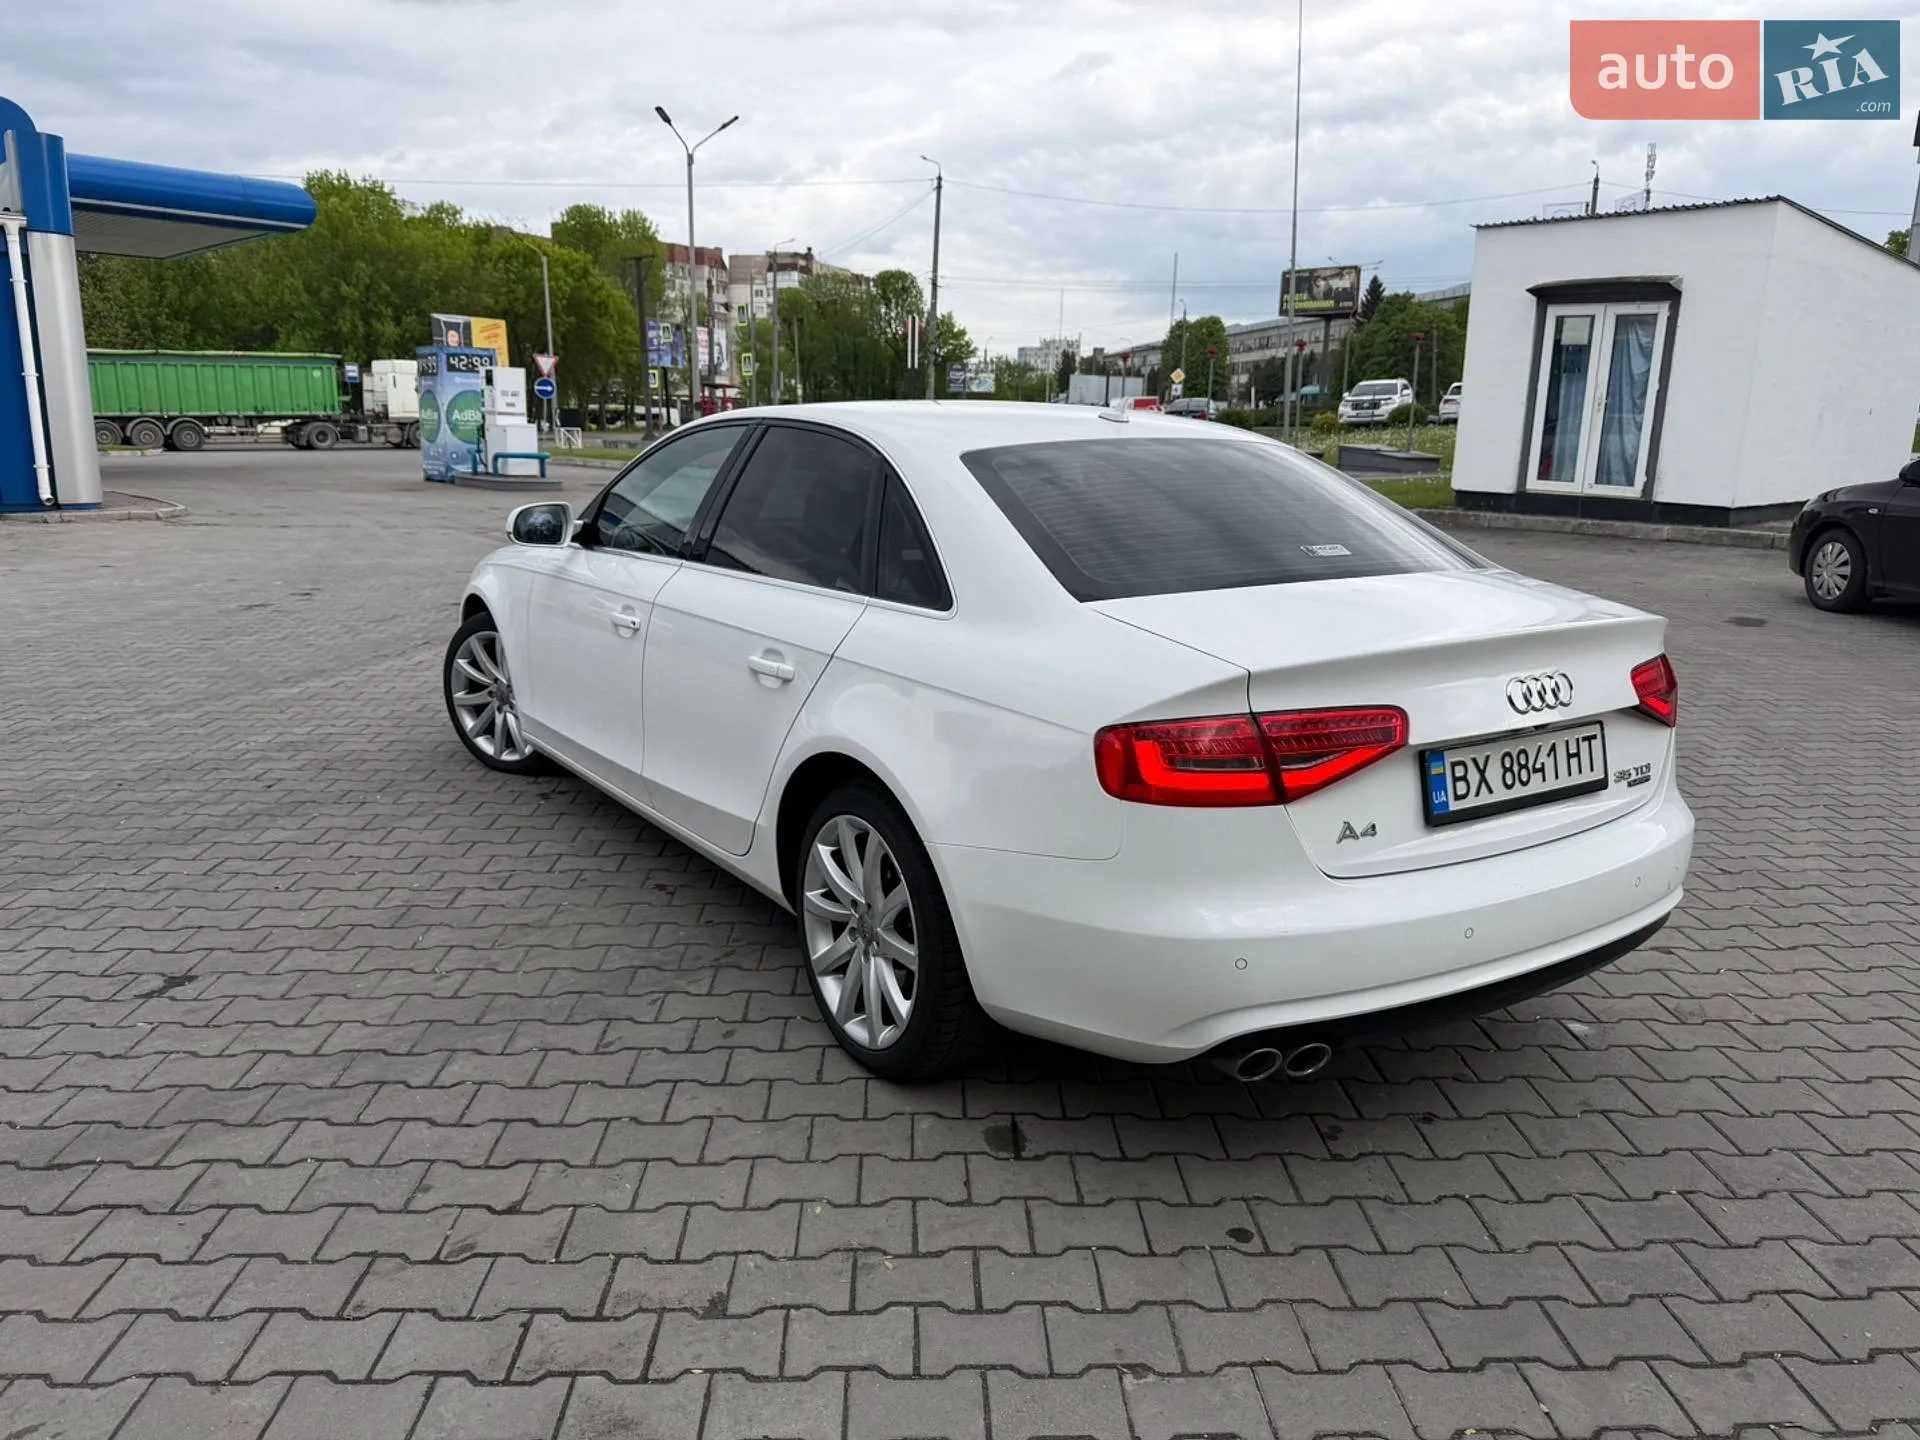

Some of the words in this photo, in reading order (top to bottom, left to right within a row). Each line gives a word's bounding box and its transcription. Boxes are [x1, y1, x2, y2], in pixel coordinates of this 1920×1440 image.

[1451, 754, 1493, 801] BX
[1500, 742, 1559, 790] 8841
[1566, 734, 1598, 778] HT
[1432, 790, 1448, 804] UA
[1336, 820, 1378, 844] A4
